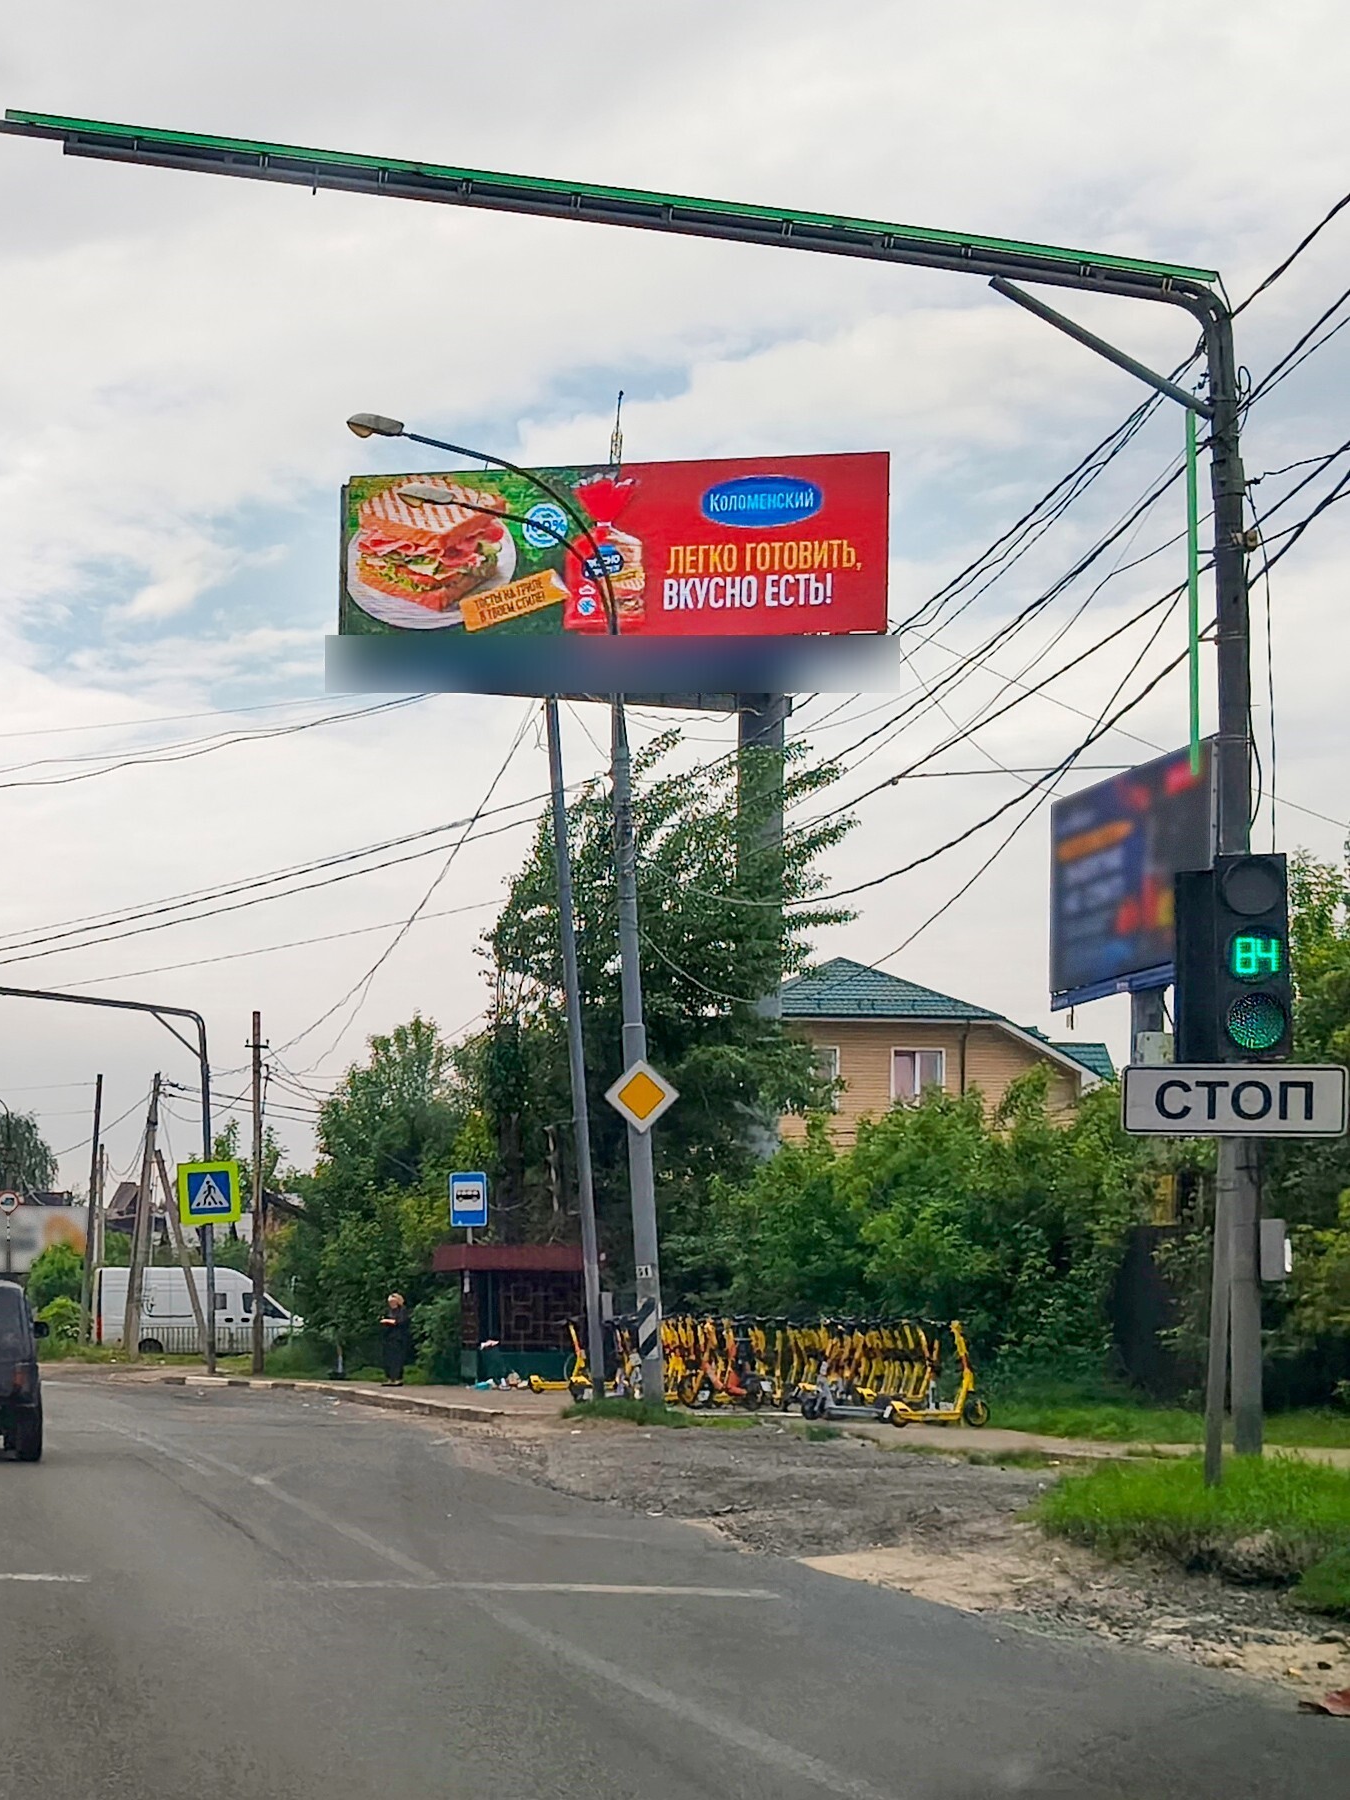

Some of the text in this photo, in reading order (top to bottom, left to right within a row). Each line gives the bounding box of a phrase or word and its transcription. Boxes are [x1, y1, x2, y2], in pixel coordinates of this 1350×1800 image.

[666, 540, 862, 574] ЛЕГКО ГОТОВИТЬ,
[663, 573, 832, 611] ВКУСНО ЕСТЬ!
[1234, 936, 1281, 975] 84
[1155, 1080, 1314, 1120] СТОП
